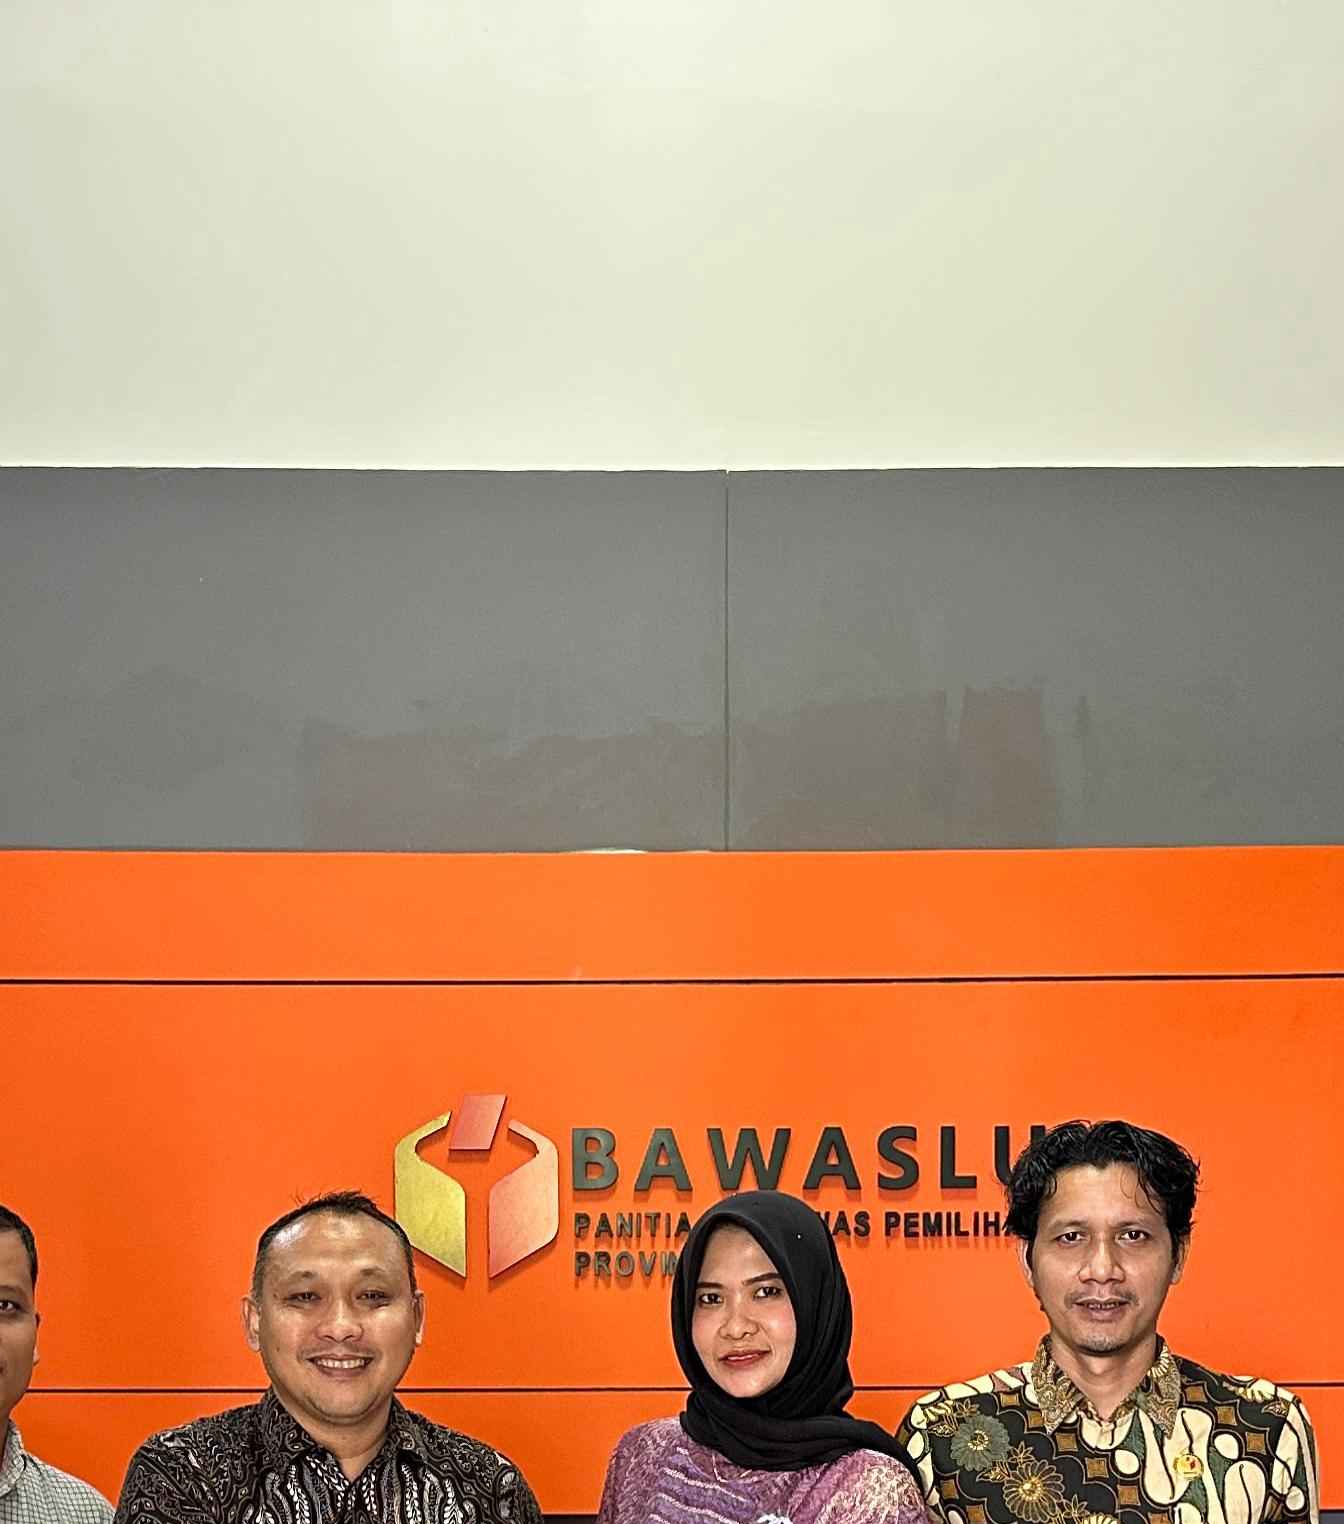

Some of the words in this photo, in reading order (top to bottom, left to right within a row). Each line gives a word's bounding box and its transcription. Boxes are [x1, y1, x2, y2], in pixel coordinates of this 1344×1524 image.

[571, 1125, 1045, 1192] BAWASLU
[574, 1211, 693, 1239] PANITIA
[884, 1209, 1012, 1238] PEMILIH
